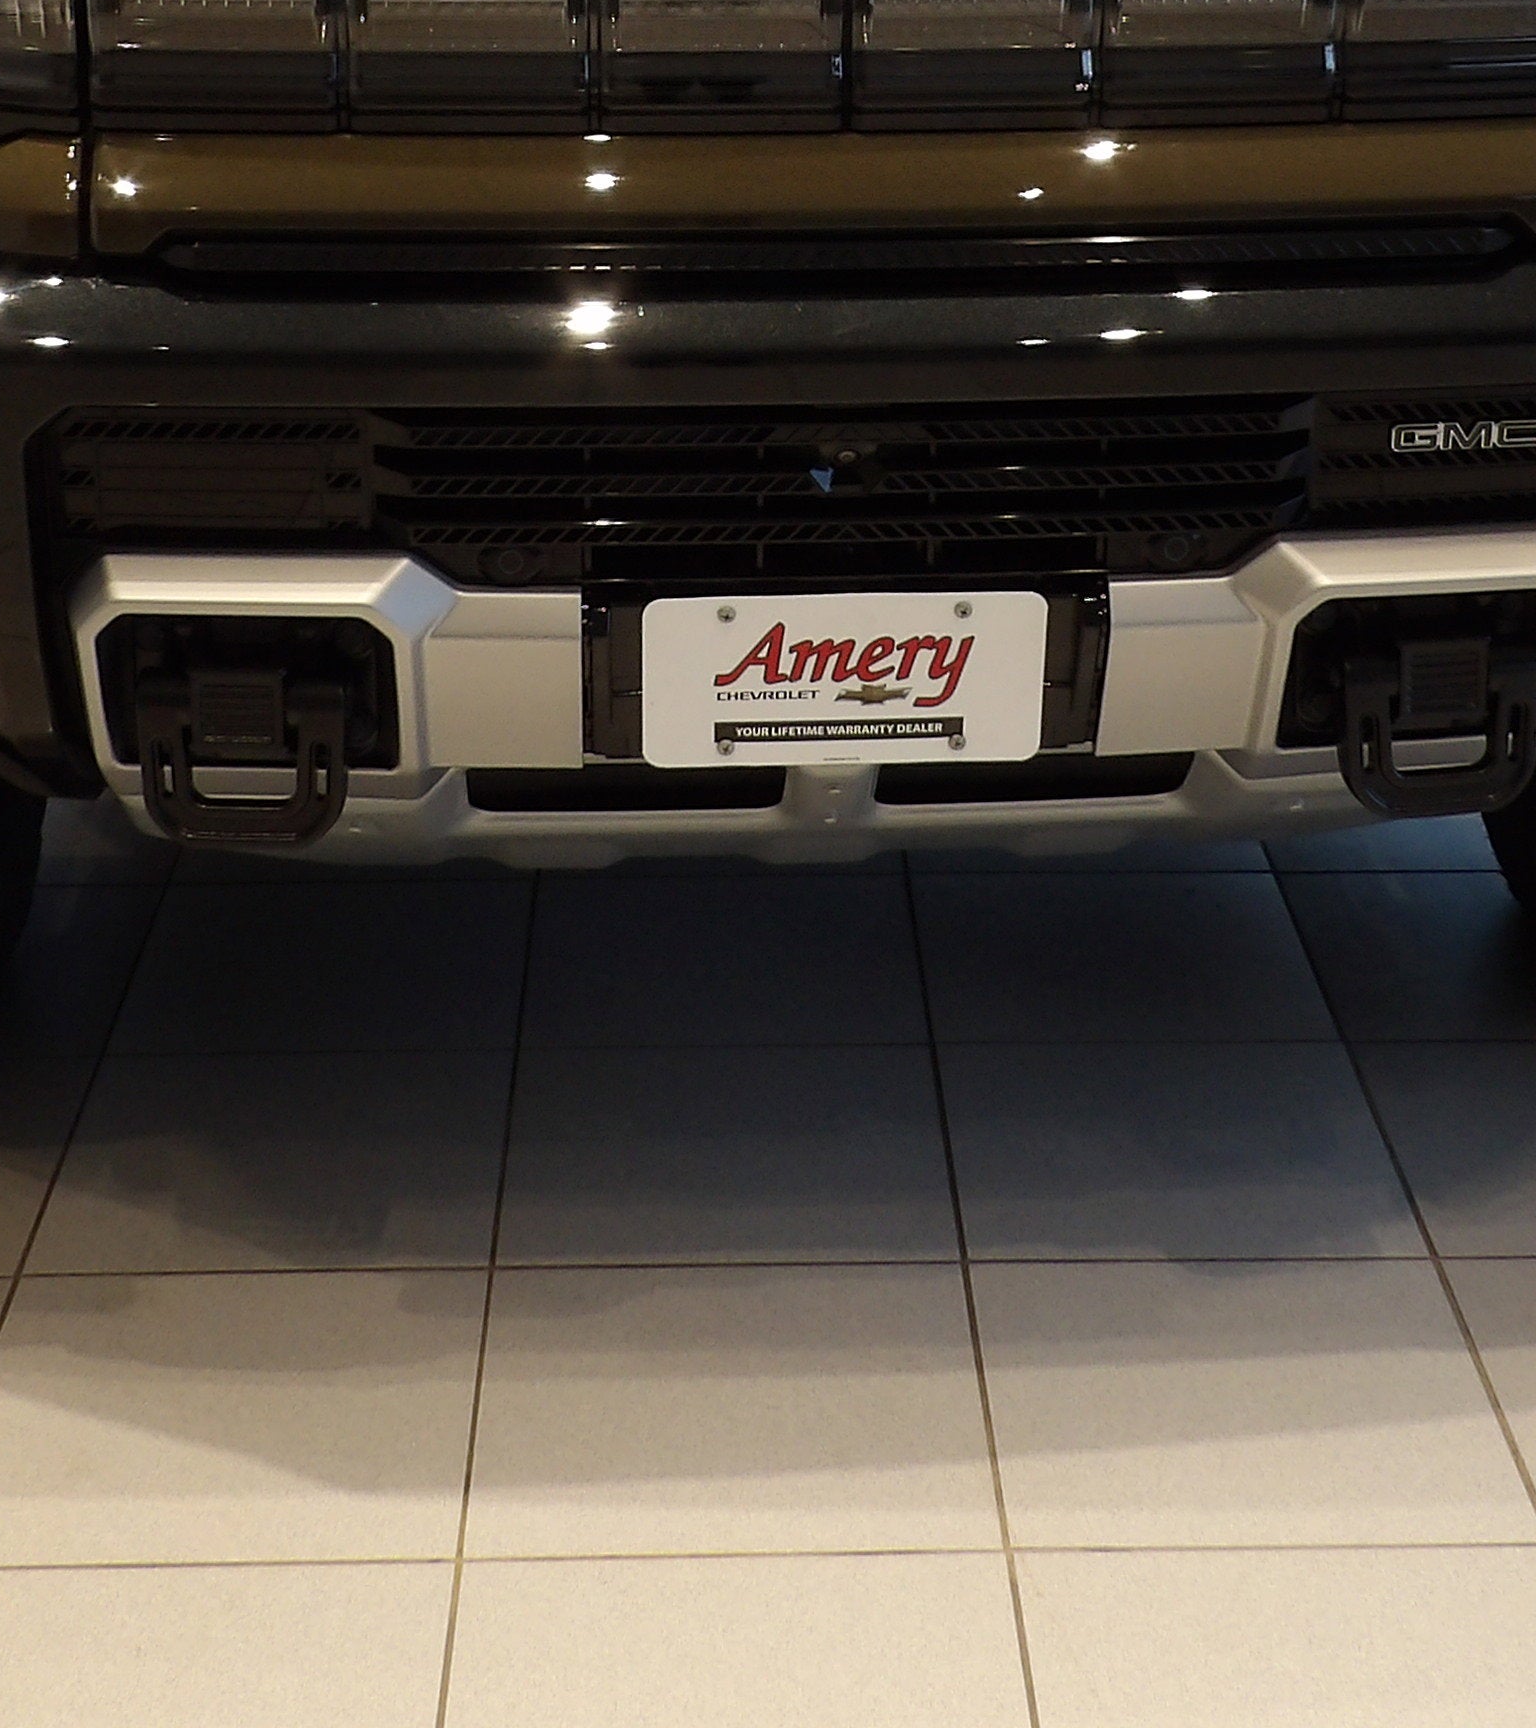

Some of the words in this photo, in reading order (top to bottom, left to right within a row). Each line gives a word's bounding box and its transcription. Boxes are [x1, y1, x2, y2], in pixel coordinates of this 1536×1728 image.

[713, 621, 975, 708] Amery
[716, 689, 820, 702] CHEVROLET
[735, 726, 769, 738] YOUR
[770, 725, 824, 737] LIFETIME
[825, 724, 894, 736] WARRANTY
[896, 722, 943, 735] DEALER
